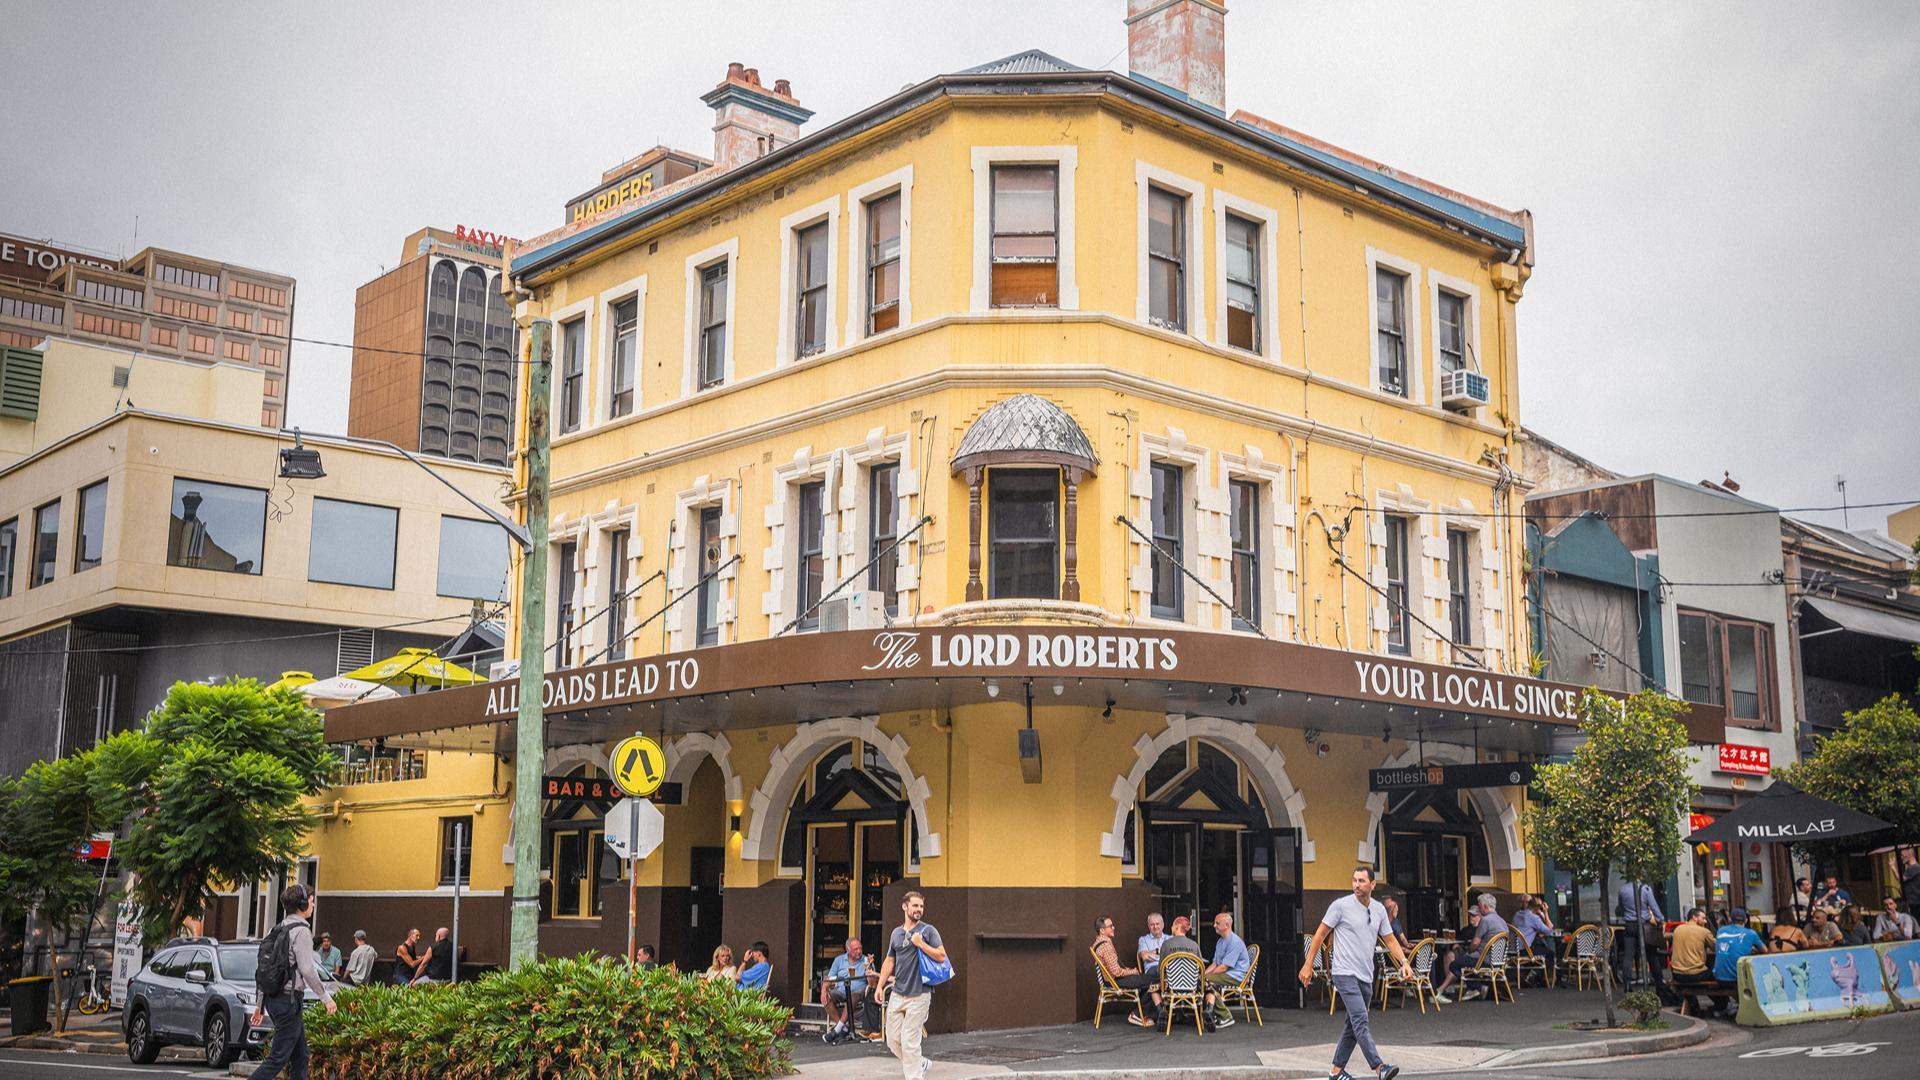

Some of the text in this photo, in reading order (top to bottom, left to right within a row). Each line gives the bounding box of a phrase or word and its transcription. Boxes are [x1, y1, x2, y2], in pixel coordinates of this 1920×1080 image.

[574, 172, 653, 222] HARDERS
[456, 223, 523, 251] BAYVI
[861, 631, 1178, 671] The LORD ROBERTS
[485, 657, 699, 717] ALL OADS LEAD TO
[1355, 660, 1427, 701] YOUR
[1432, 671, 1511, 712] LOCAL
[1515, 683, 1578, 720] SINCE
[548, 780, 585, 797] BAR
[592, 783, 603, 797] &
[1376, 767, 1444, 786] bottleshop
[1737, 818, 1835, 837] MILKLAB
